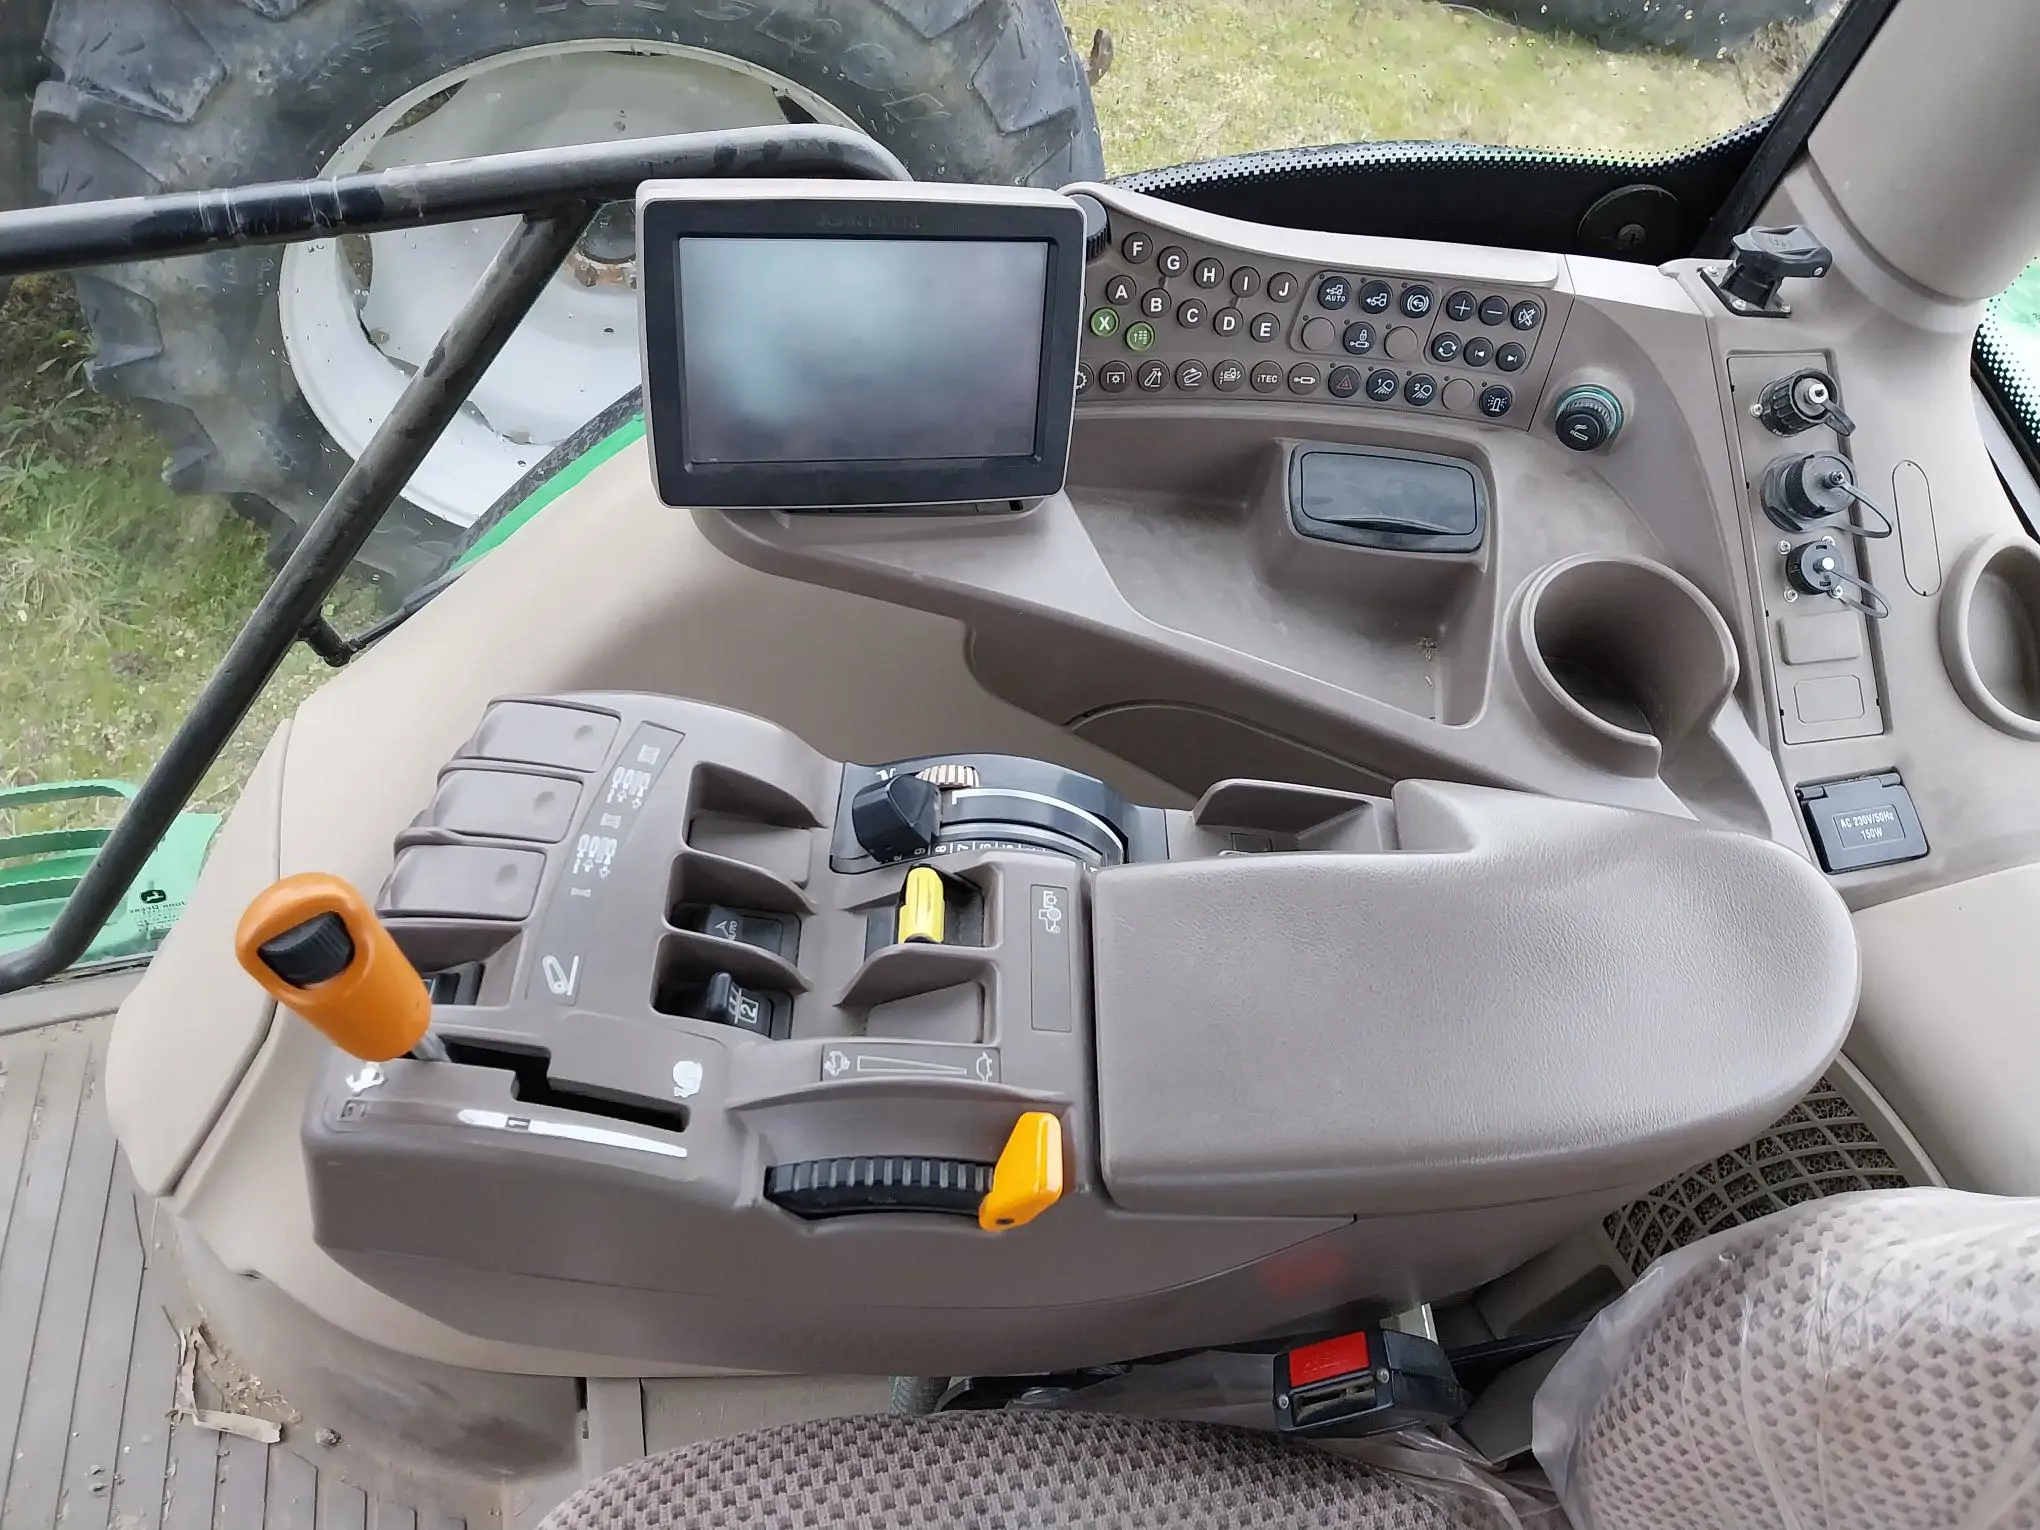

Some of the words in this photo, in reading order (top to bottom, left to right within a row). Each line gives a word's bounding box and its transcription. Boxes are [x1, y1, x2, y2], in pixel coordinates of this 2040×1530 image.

[1132, 241, 1144, 257] F
[1166, 255, 1181, 271] G
[1203, 267, 1216, 283] H
[1243, 276, 1249, 291] I
[1278, 281, 1290, 297] J
[1114, 284, 1129, 300] A
[1324, 294, 1347, 303] AUTO
[1150, 297, 1163, 313] B
[1098, 315, 1111, 331] X
[1186, 308, 1199, 323] C
[1223, 316, 1236, 331] D
[1259, 322, 1272, 337] E
[1257, 373, 1278, 384] iTEC
[1413, 382, 1421, 392] 2
[1840, 818, 1853, 829] AC
[1853, 811, 1894, 827] 230V/50Hz
[1860, 827, 1883, 840] 150W
[934, 844, 947, 854] 8
